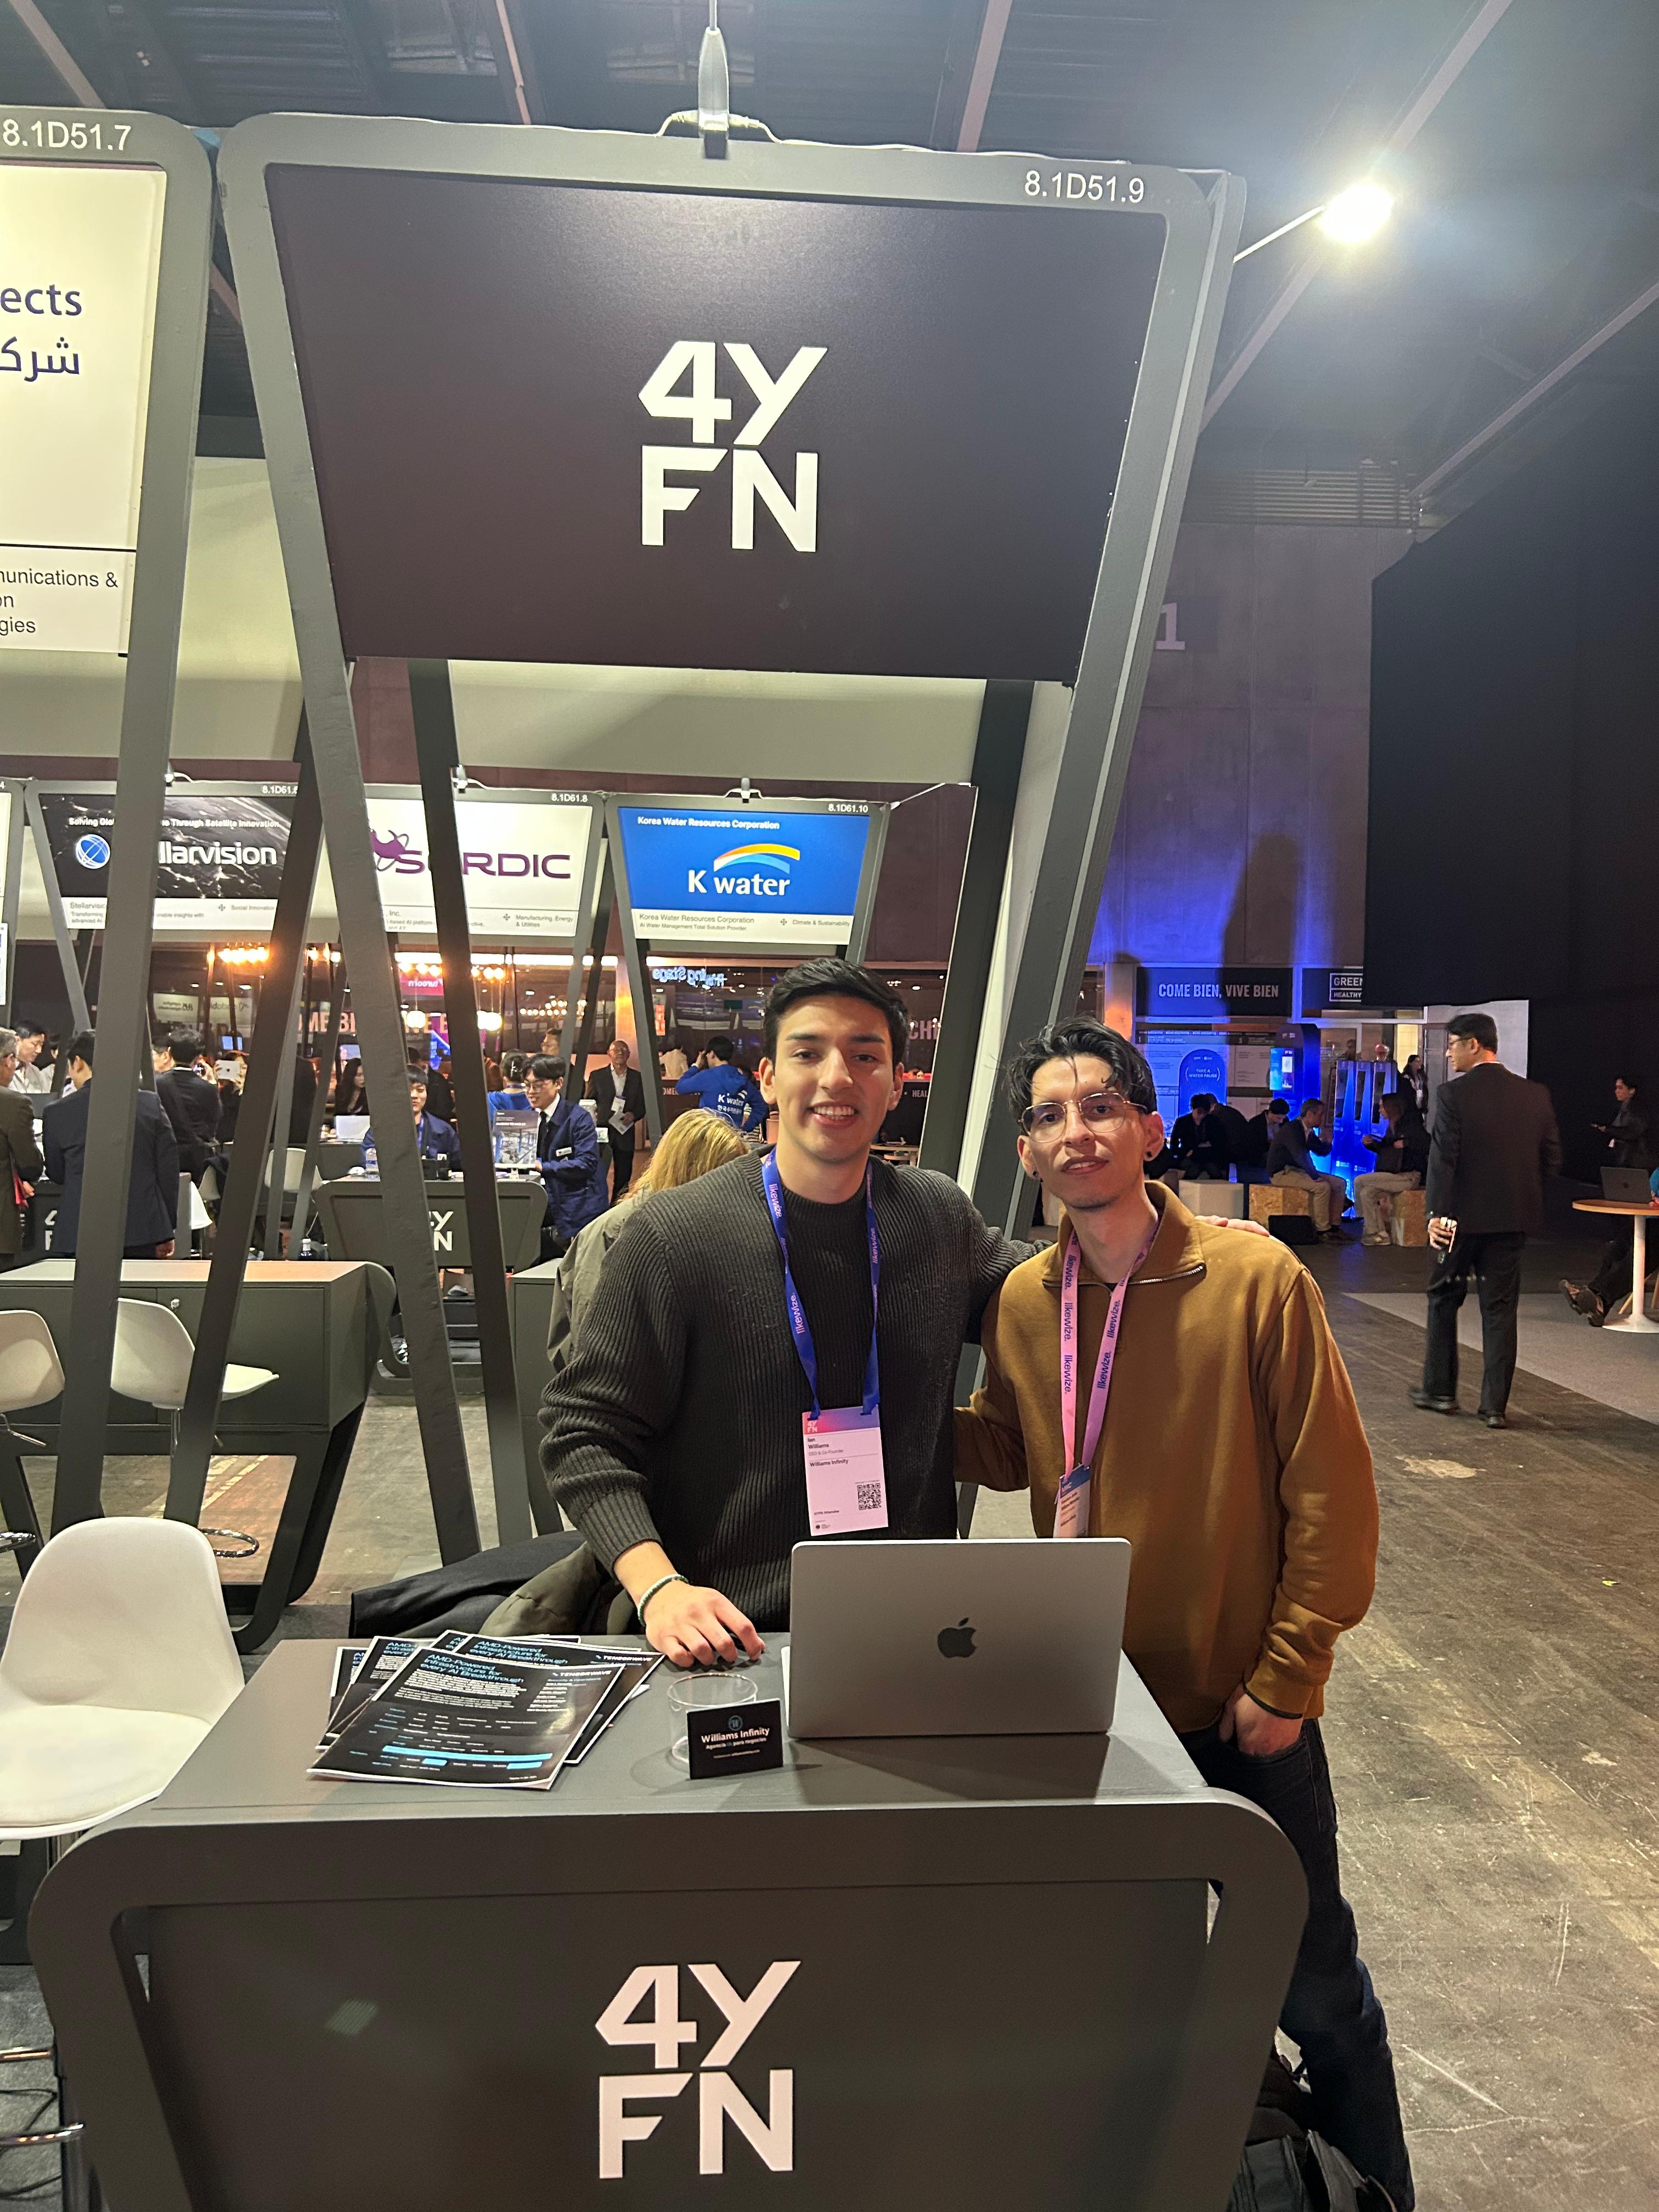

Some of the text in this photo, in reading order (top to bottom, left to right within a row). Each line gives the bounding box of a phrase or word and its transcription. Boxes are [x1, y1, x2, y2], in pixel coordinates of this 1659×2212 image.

[2, 120, 132, 151] 8.1D51.7
[1024, 171, 1145, 204] 8.1D51.9
[638, 340, 828, 445] 4Y
[641, 445, 819, 553] FN
[0, 568, 119, 588] unications &
[551, 793, 588, 803] 8.1D61.8
[828, 803, 868, 813] 8.1D61.10
[171, 819, 204, 828] Through
[205, 819, 238, 827] Satellite
[239, 820, 280, 828] Innovation
[637, 816, 780, 830] Korea Water Resources Corporation
[159, 841, 278, 865] llarvision
[395, 850, 571, 879] SRDIC
[688, 870, 791, 896] K water
[1158, 983, 1279, 999] COME BIEN, VIVE BIEN
[477, 1640, 542, 1653] AMD-Powered
[424, 1658, 486, 1674] Infrastructure
[427, 1654, 496, 1670] AMD-Powered
[507, 1654, 568, 1664] Breakthrough
[420, 1663, 447, 1672] every
[460, 1671, 524, 1683] Breakthrough
[701, 1726, 770, 1743] Williams Infinity
[595, 1960, 801, 2069] 4Y
[599, 2069, 793, 2179] FN
